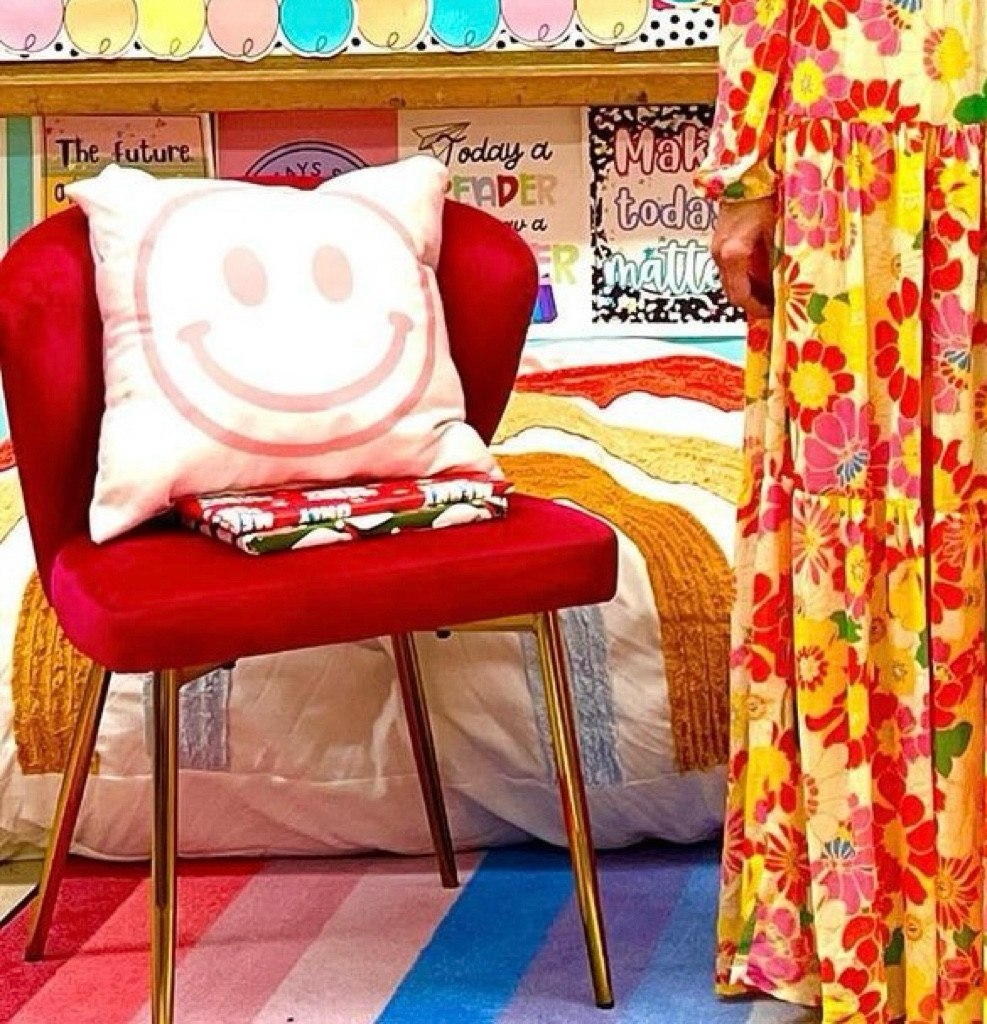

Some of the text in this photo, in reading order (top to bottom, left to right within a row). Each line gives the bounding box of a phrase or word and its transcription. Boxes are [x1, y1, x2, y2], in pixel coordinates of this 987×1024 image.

[55, 134, 191, 168] The future
[435, 134, 553, 171] Today a
[613, 122, 708, 176] Mak
[445, 172, 558, 209] EADER
[614, 183, 719, 232] toda
[531, 217, 548, 232] a
